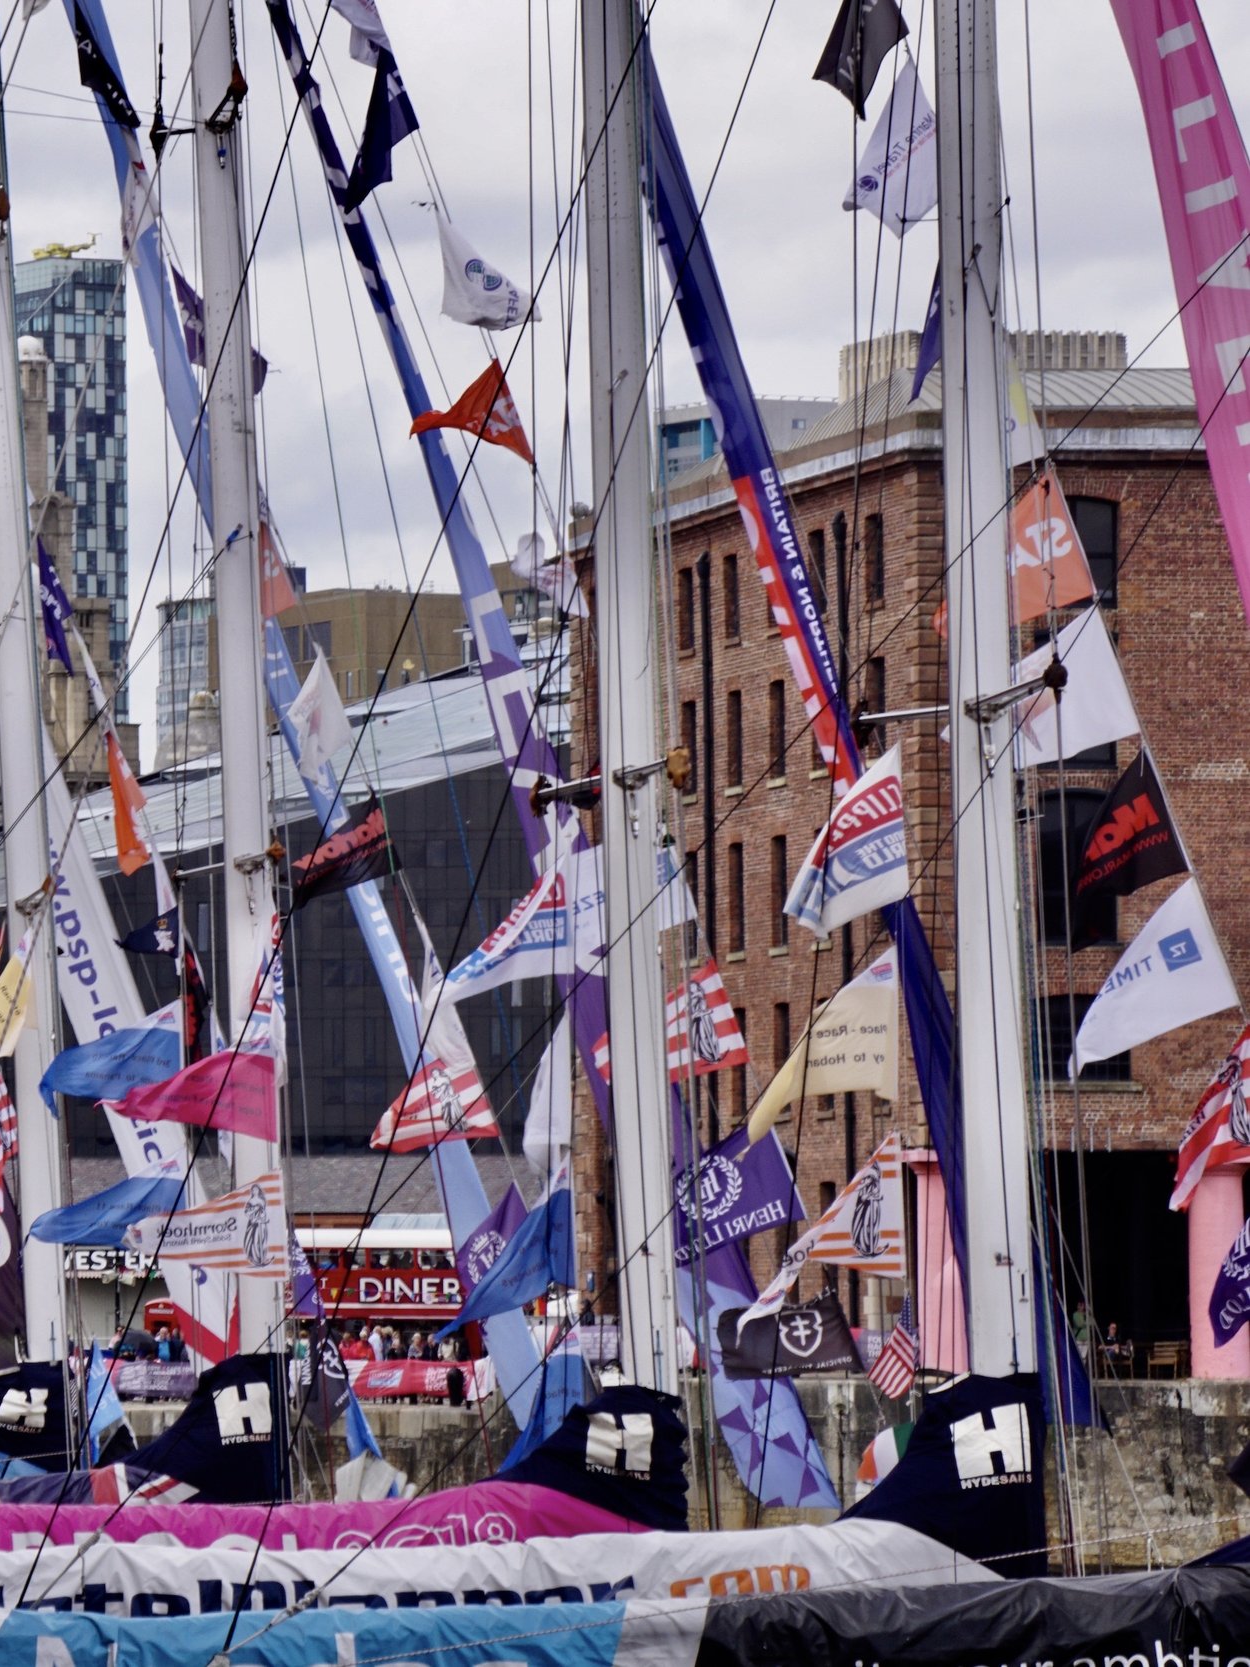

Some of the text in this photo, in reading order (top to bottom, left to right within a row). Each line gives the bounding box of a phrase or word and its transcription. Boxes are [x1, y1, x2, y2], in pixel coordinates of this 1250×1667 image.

[359, 1276, 463, 1303] DINER
[213, 1382, 273, 1437] H
[949, 1402, 1032, 1480] H
